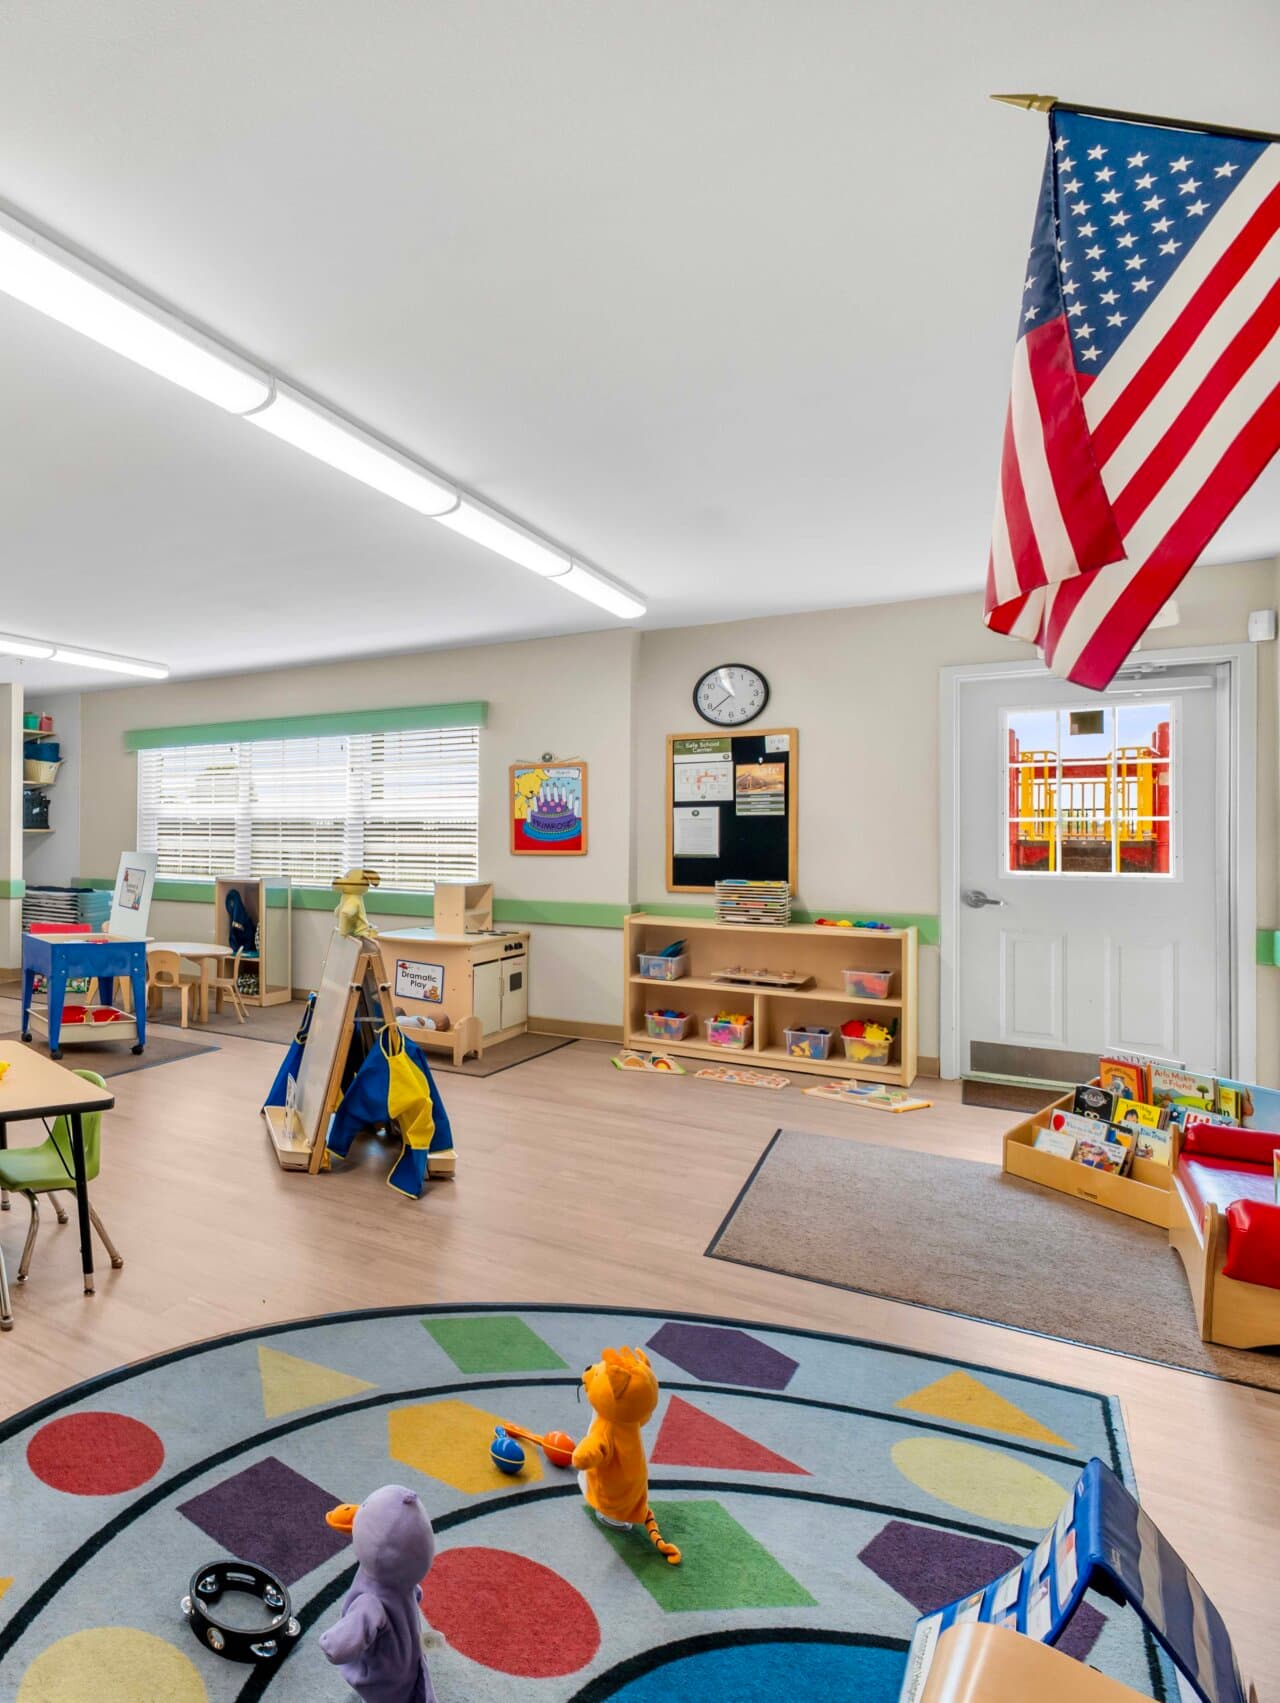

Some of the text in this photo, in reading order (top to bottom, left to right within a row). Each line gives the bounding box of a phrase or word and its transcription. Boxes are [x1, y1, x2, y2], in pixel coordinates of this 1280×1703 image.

[703, 693, 710, 701] 9
[753, 689, 759, 697] 3
[401, 970, 438, 982] Dramatic
[410, 980, 427, 989] Play
